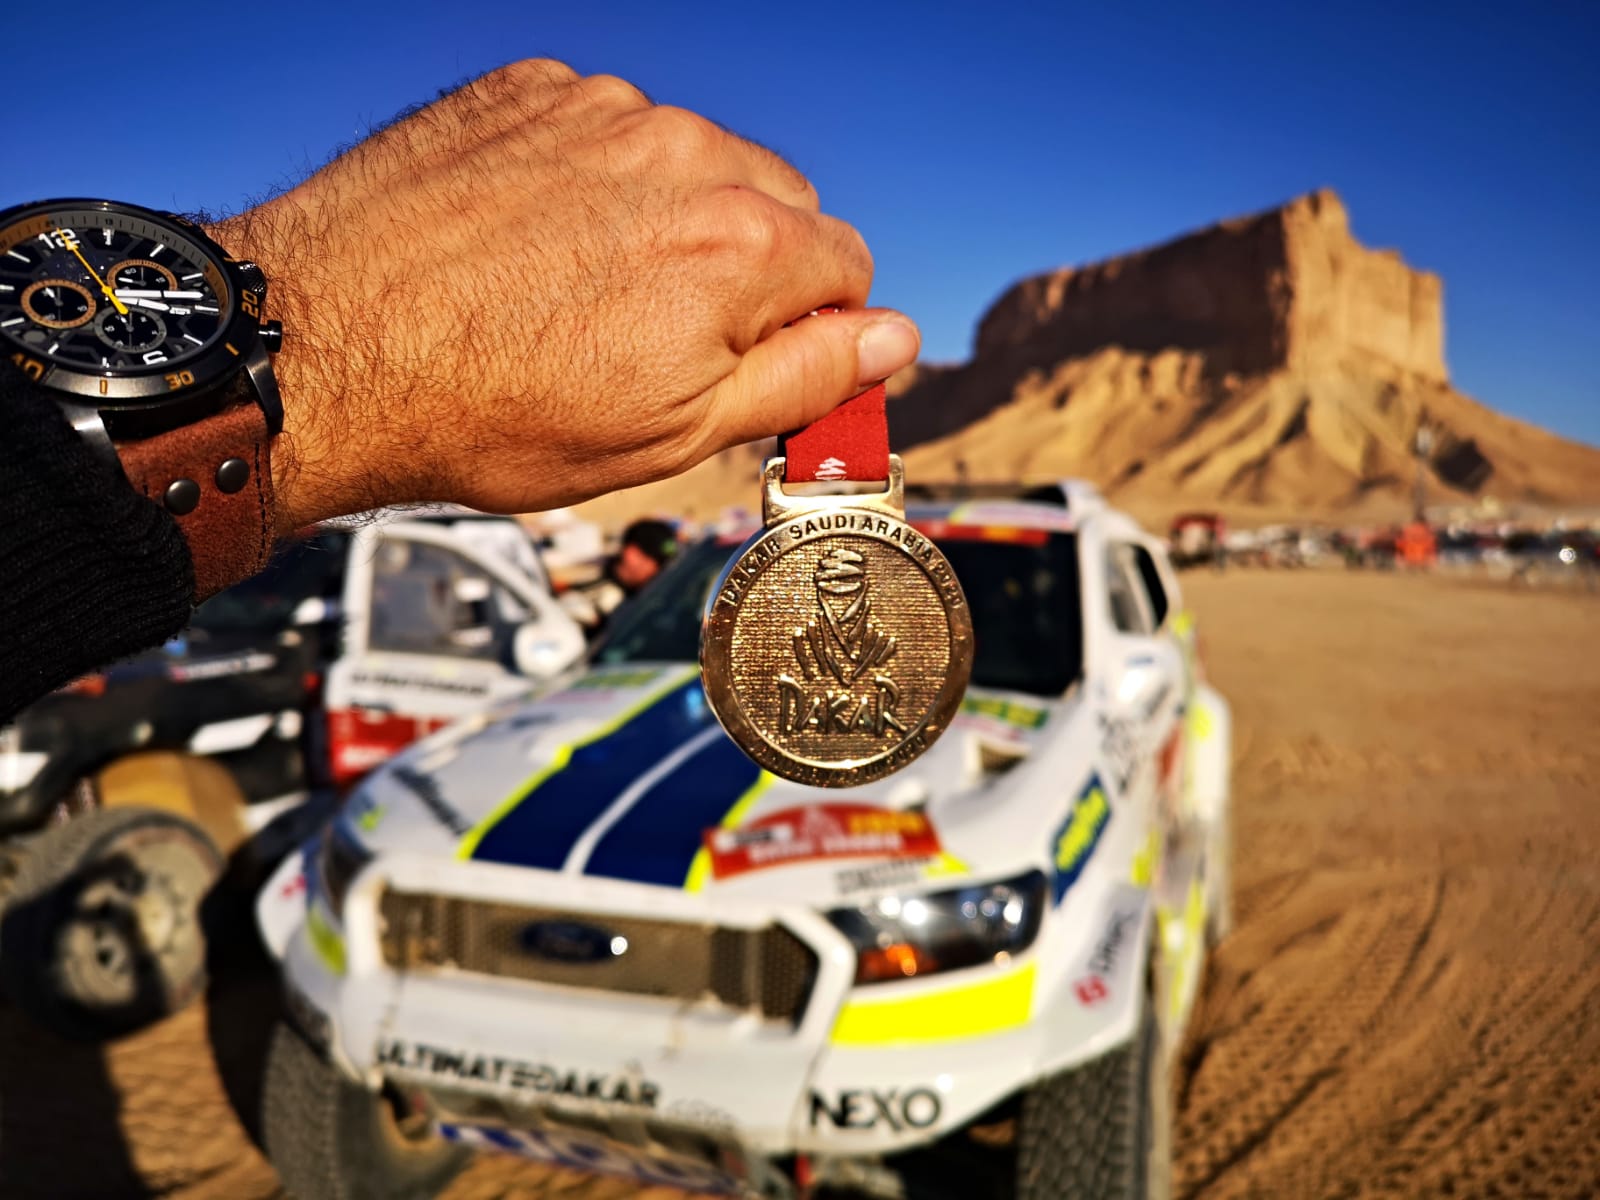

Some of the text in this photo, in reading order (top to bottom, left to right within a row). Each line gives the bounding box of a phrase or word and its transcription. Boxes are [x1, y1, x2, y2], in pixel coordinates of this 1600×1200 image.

[39, 228, 80, 249] 12
[241, 289, 259, 318] 20
[164, 370, 194, 391] 30
[722, 539, 781, 606] DAKAR
[789, 514, 856, 540] SAUDI
[862, 518, 932, 565] ARABIA
[778, 674, 908, 737] DAKAR
[809, 1087, 942, 1132] NEXO
